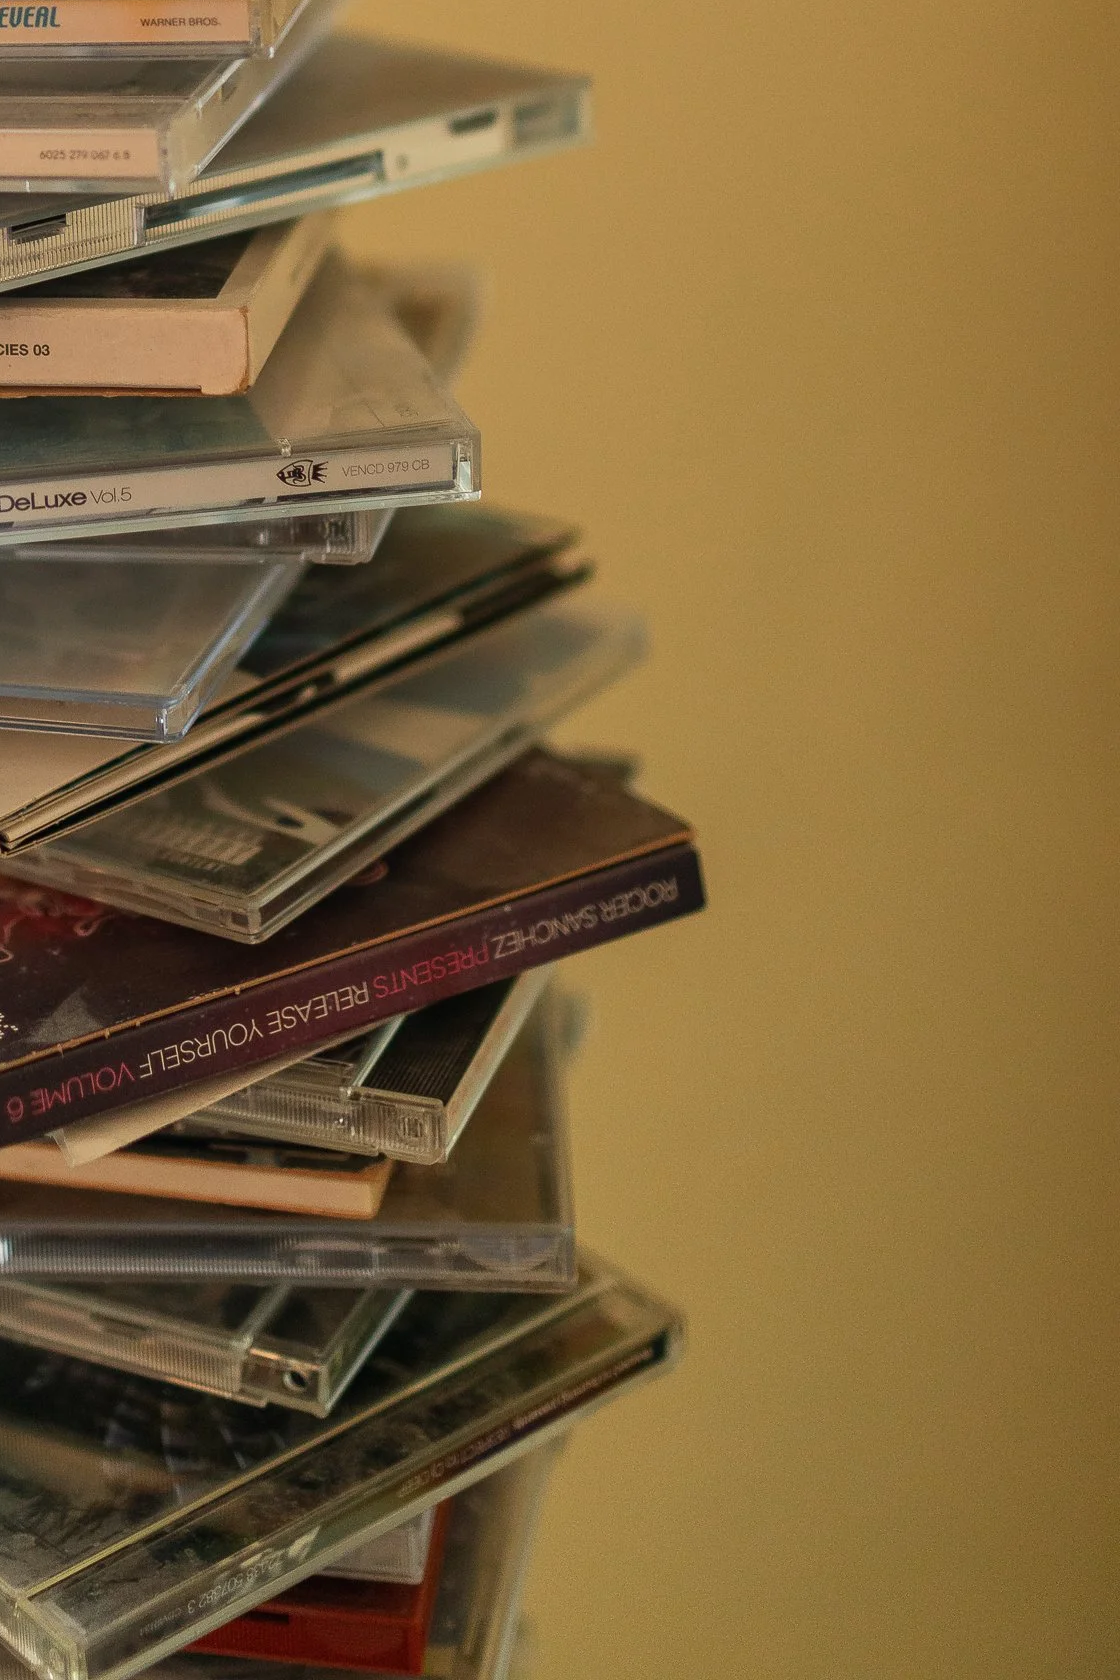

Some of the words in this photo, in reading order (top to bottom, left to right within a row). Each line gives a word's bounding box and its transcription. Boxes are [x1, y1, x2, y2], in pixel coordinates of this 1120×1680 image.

[140, 17, 186, 27] WARNER
[32, 343, 50, 356] 03
[90, 486, 132, 504] Vol.5
[341, 461, 385, 478] VENCD
[387, 460, 409, 474] 979
[411, 458, 430, 471] CB
[490, 902, 600, 960] SANCHEZ
[372, 942, 490, 999] PRESENTS
[266, 981, 370, 1035] RELEASE
[139, 1018, 265, 1079] YOURSELF
[6, 1094, 25, 1122] 6
[31, 1061, 137, 1117] VOLUME
